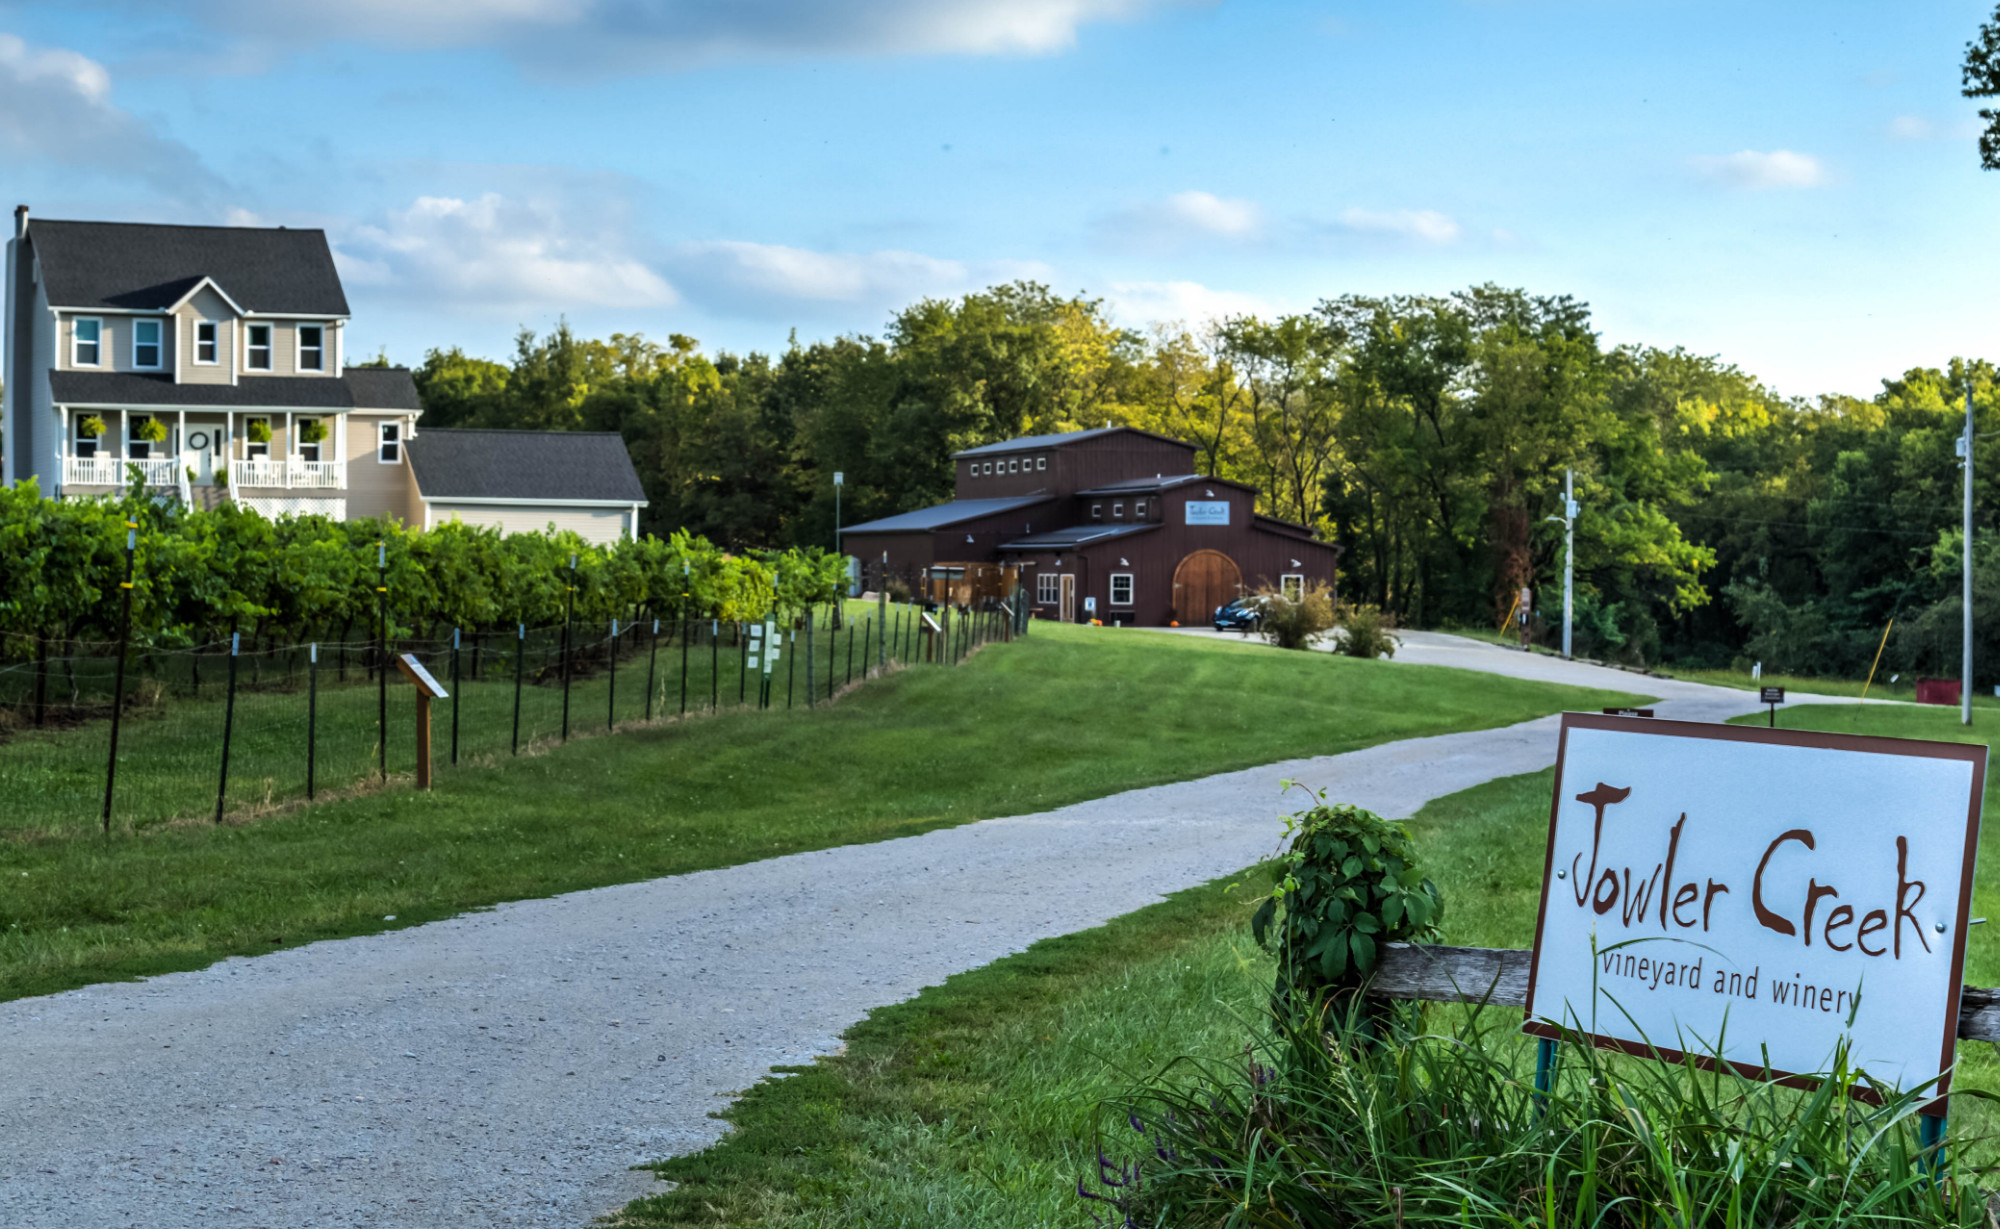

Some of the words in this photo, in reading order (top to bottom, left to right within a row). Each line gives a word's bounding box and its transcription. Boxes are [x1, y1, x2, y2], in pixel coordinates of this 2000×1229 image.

[1573, 783, 1729, 932] Jowler
[1752, 829, 1931, 960] Creek
[1603, 950, 1703, 991] vineyard
[1713, 965, 1760, 1000] and
